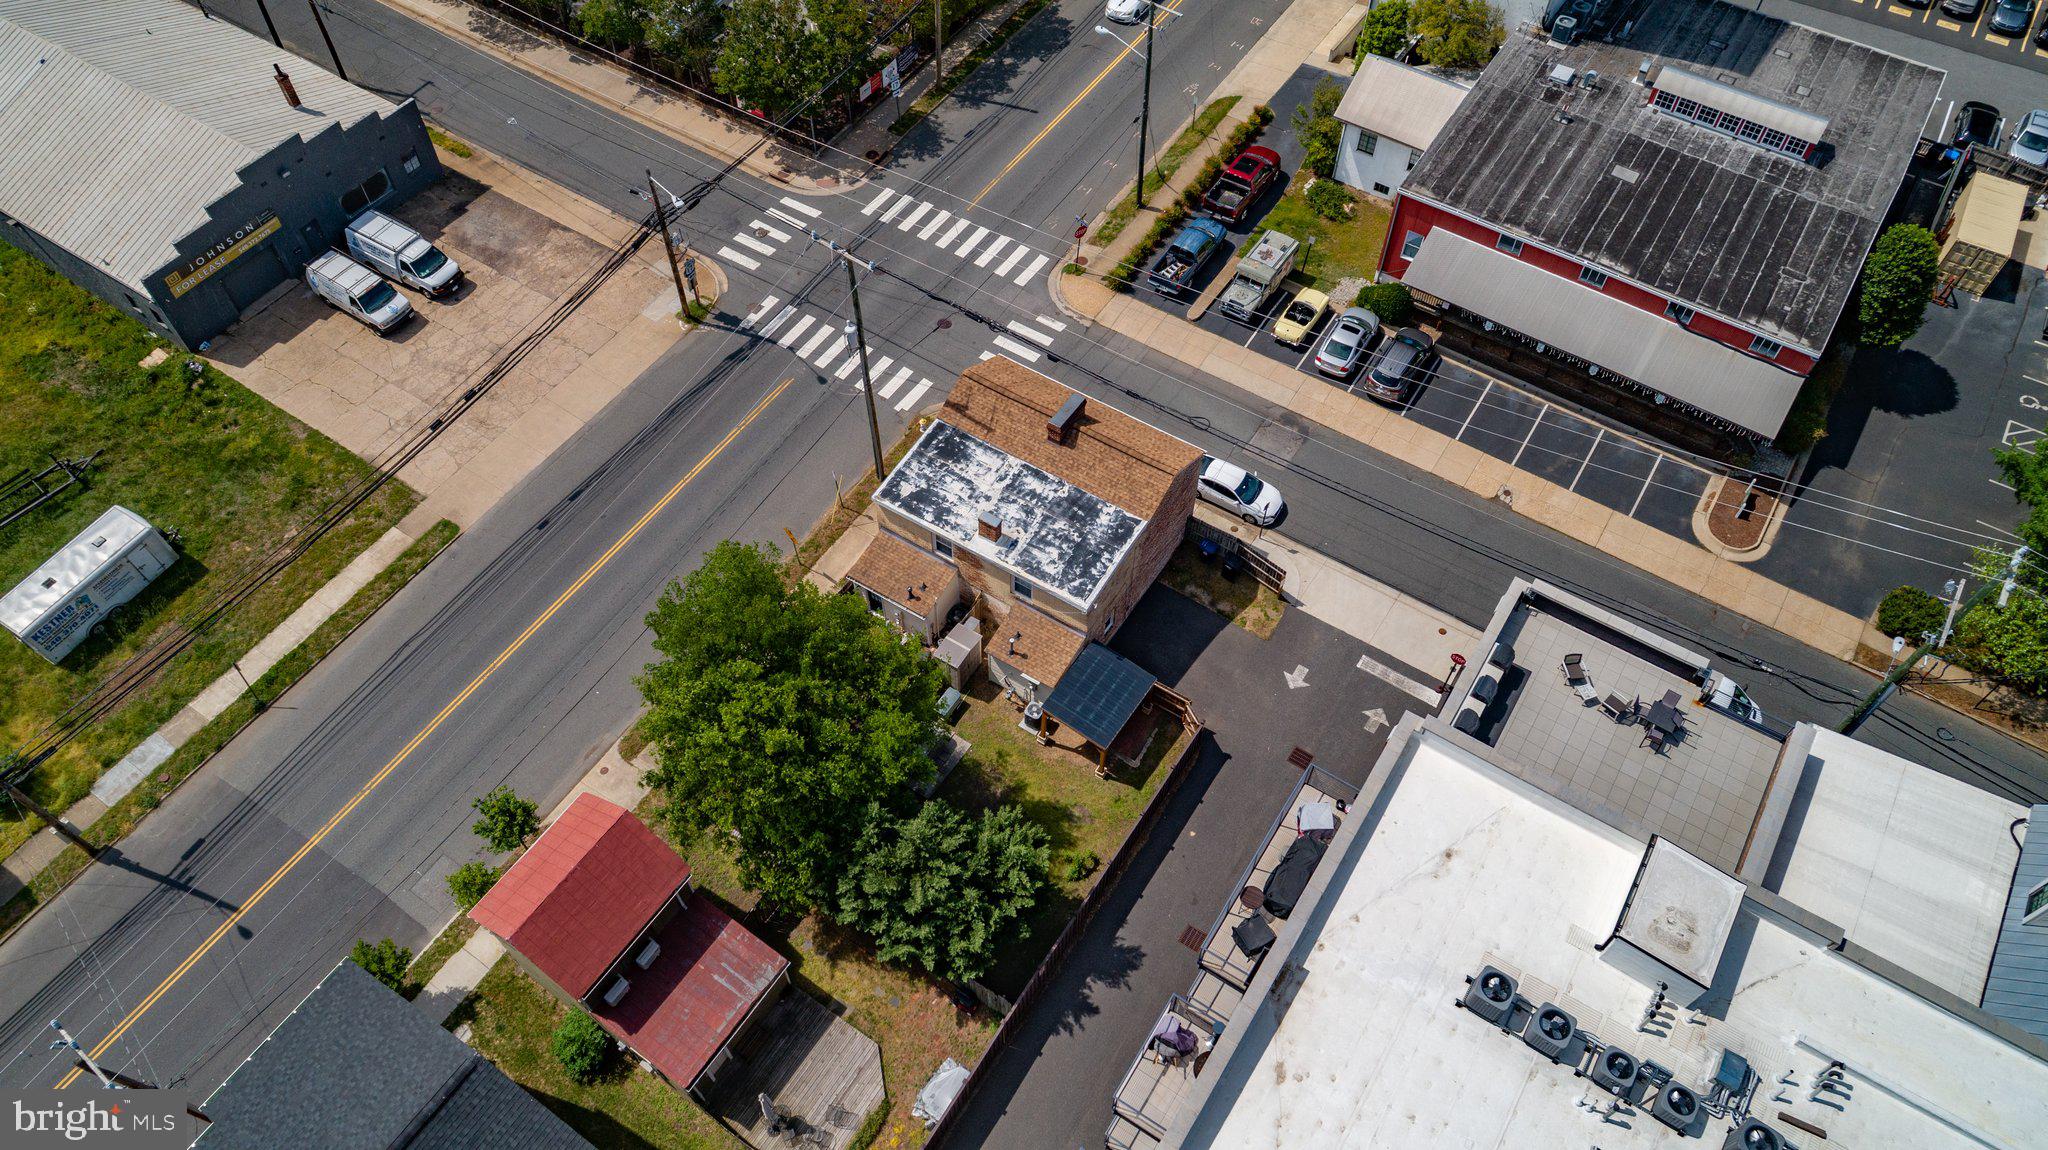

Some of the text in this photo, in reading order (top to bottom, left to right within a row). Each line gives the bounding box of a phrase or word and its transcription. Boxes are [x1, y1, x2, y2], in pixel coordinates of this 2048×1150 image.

[189, 223, 255, 272] JOHNSON
[176, 256, 227, 294] FOR LEASE
[31, 604, 75, 642] KESTNER
[1451, 655, 1465, 663] STOP
